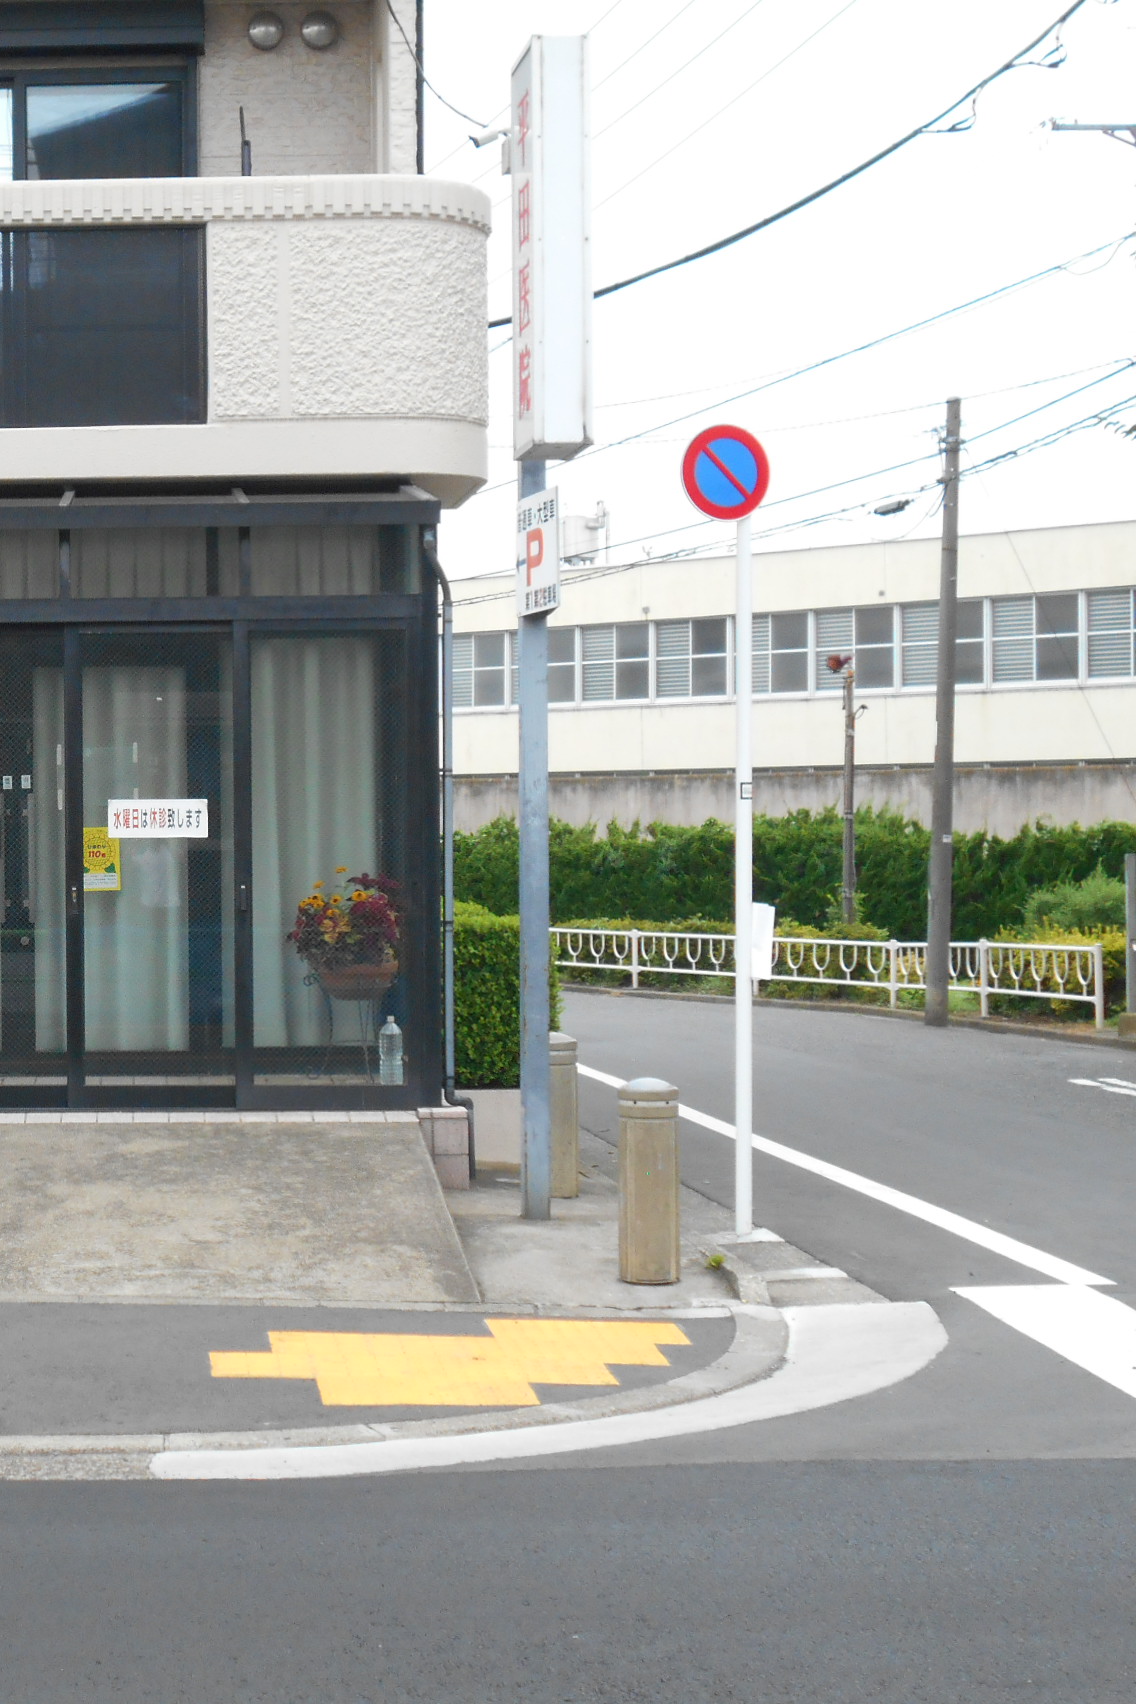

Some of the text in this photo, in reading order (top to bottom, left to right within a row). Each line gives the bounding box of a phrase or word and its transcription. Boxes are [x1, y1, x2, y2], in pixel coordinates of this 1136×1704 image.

[517, 87, 532, 421] 平田医院
[526, 527, 544, 587] P
[113, 807, 202, 829] 水曜日は休診致します
